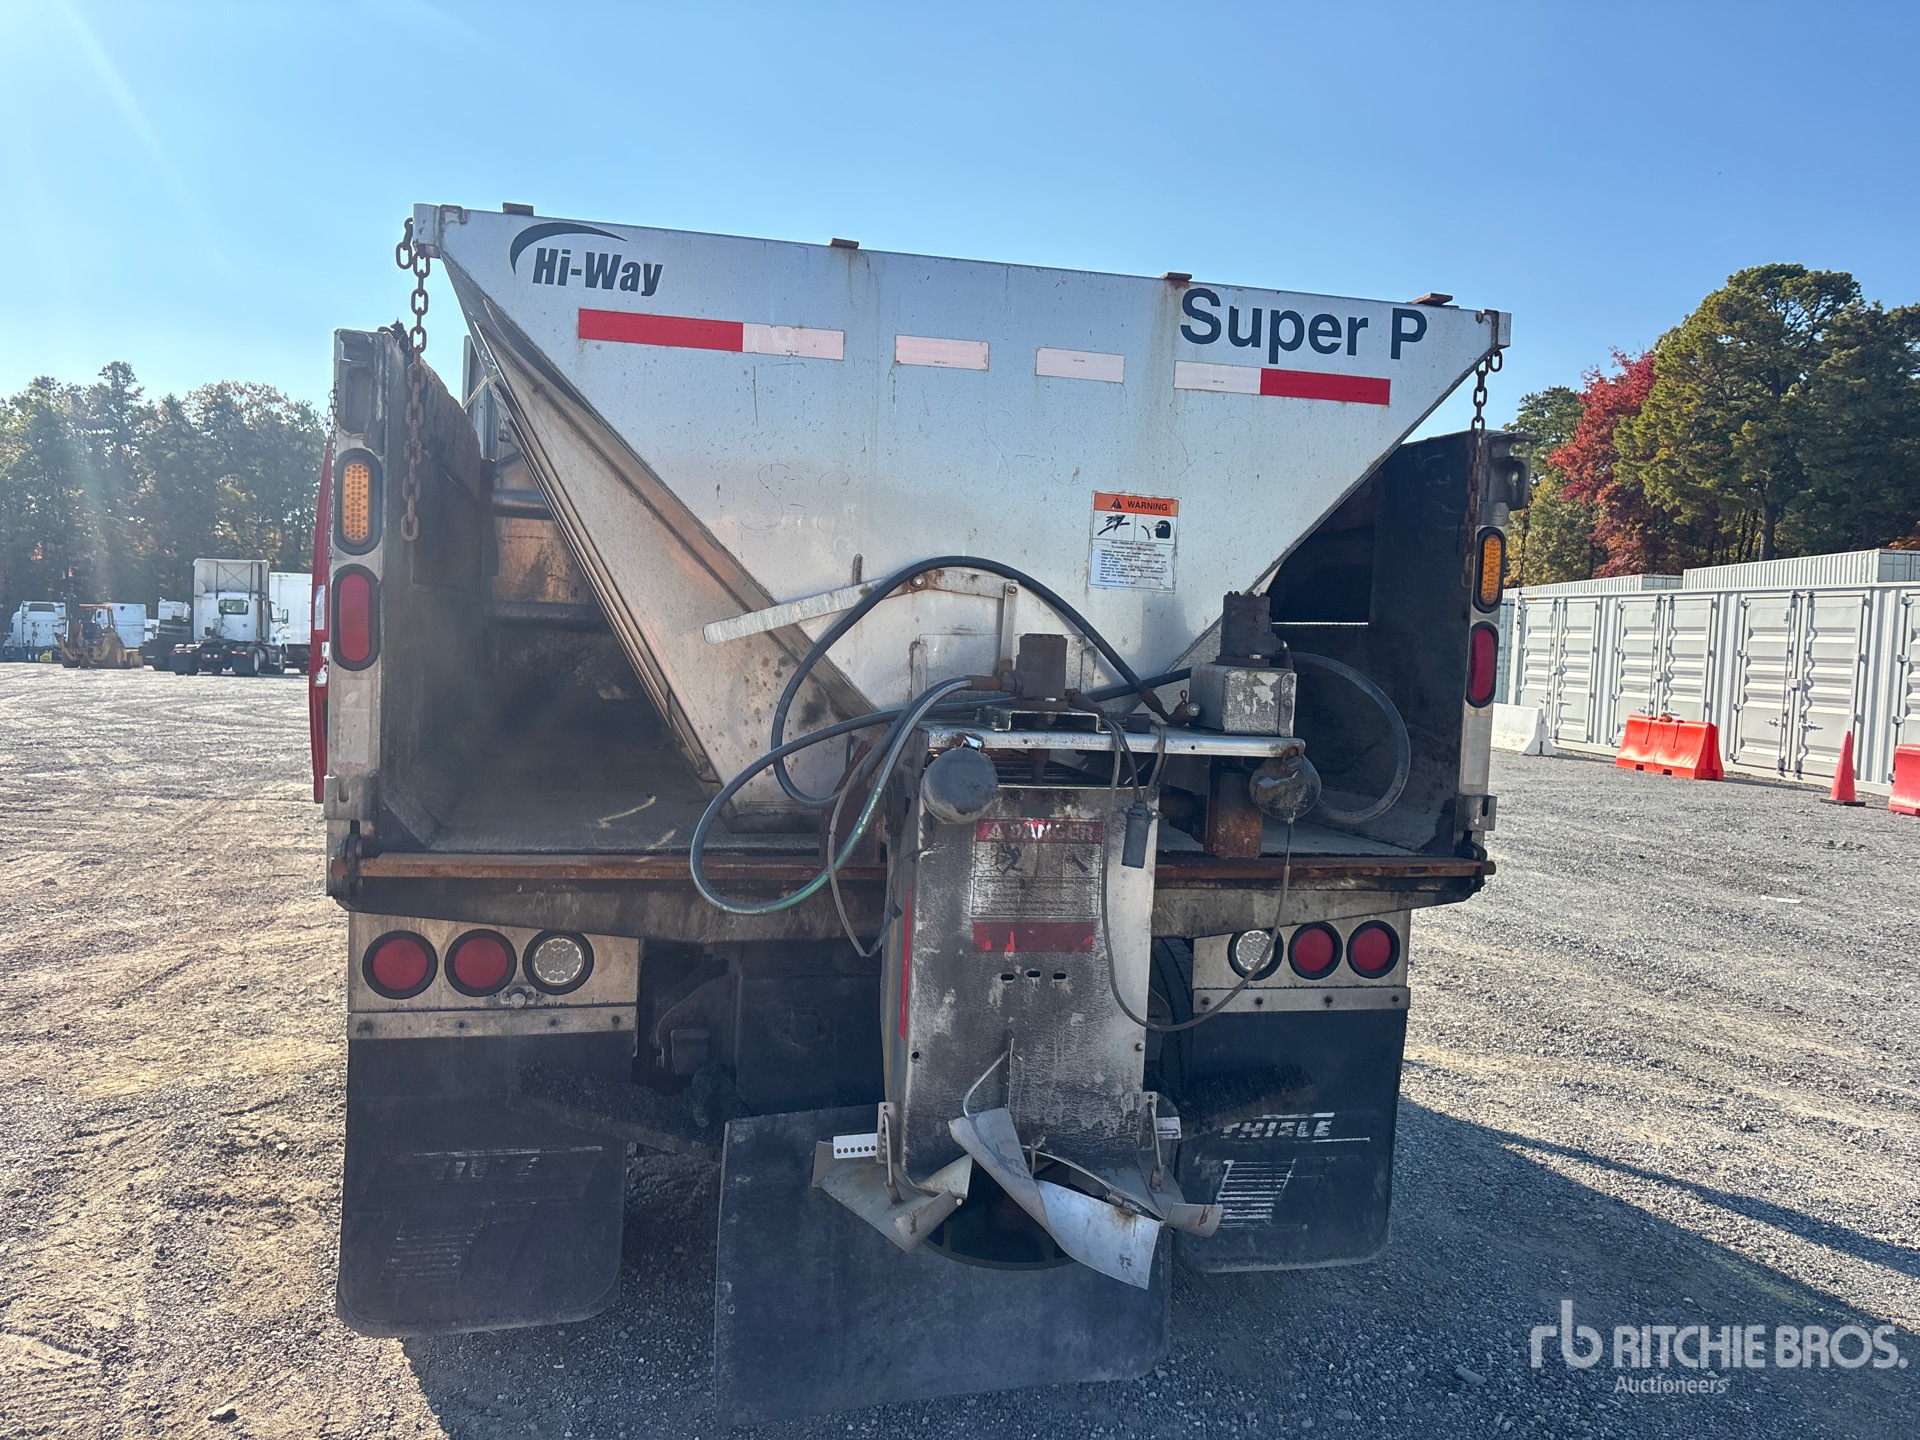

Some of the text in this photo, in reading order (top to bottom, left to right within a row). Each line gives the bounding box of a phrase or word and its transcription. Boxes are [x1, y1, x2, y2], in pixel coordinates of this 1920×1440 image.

[532, 247, 664, 297] Hi-Way
[1180, 287, 1428, 365] Super P
[1127, 500, 1168, 511] WARNING
